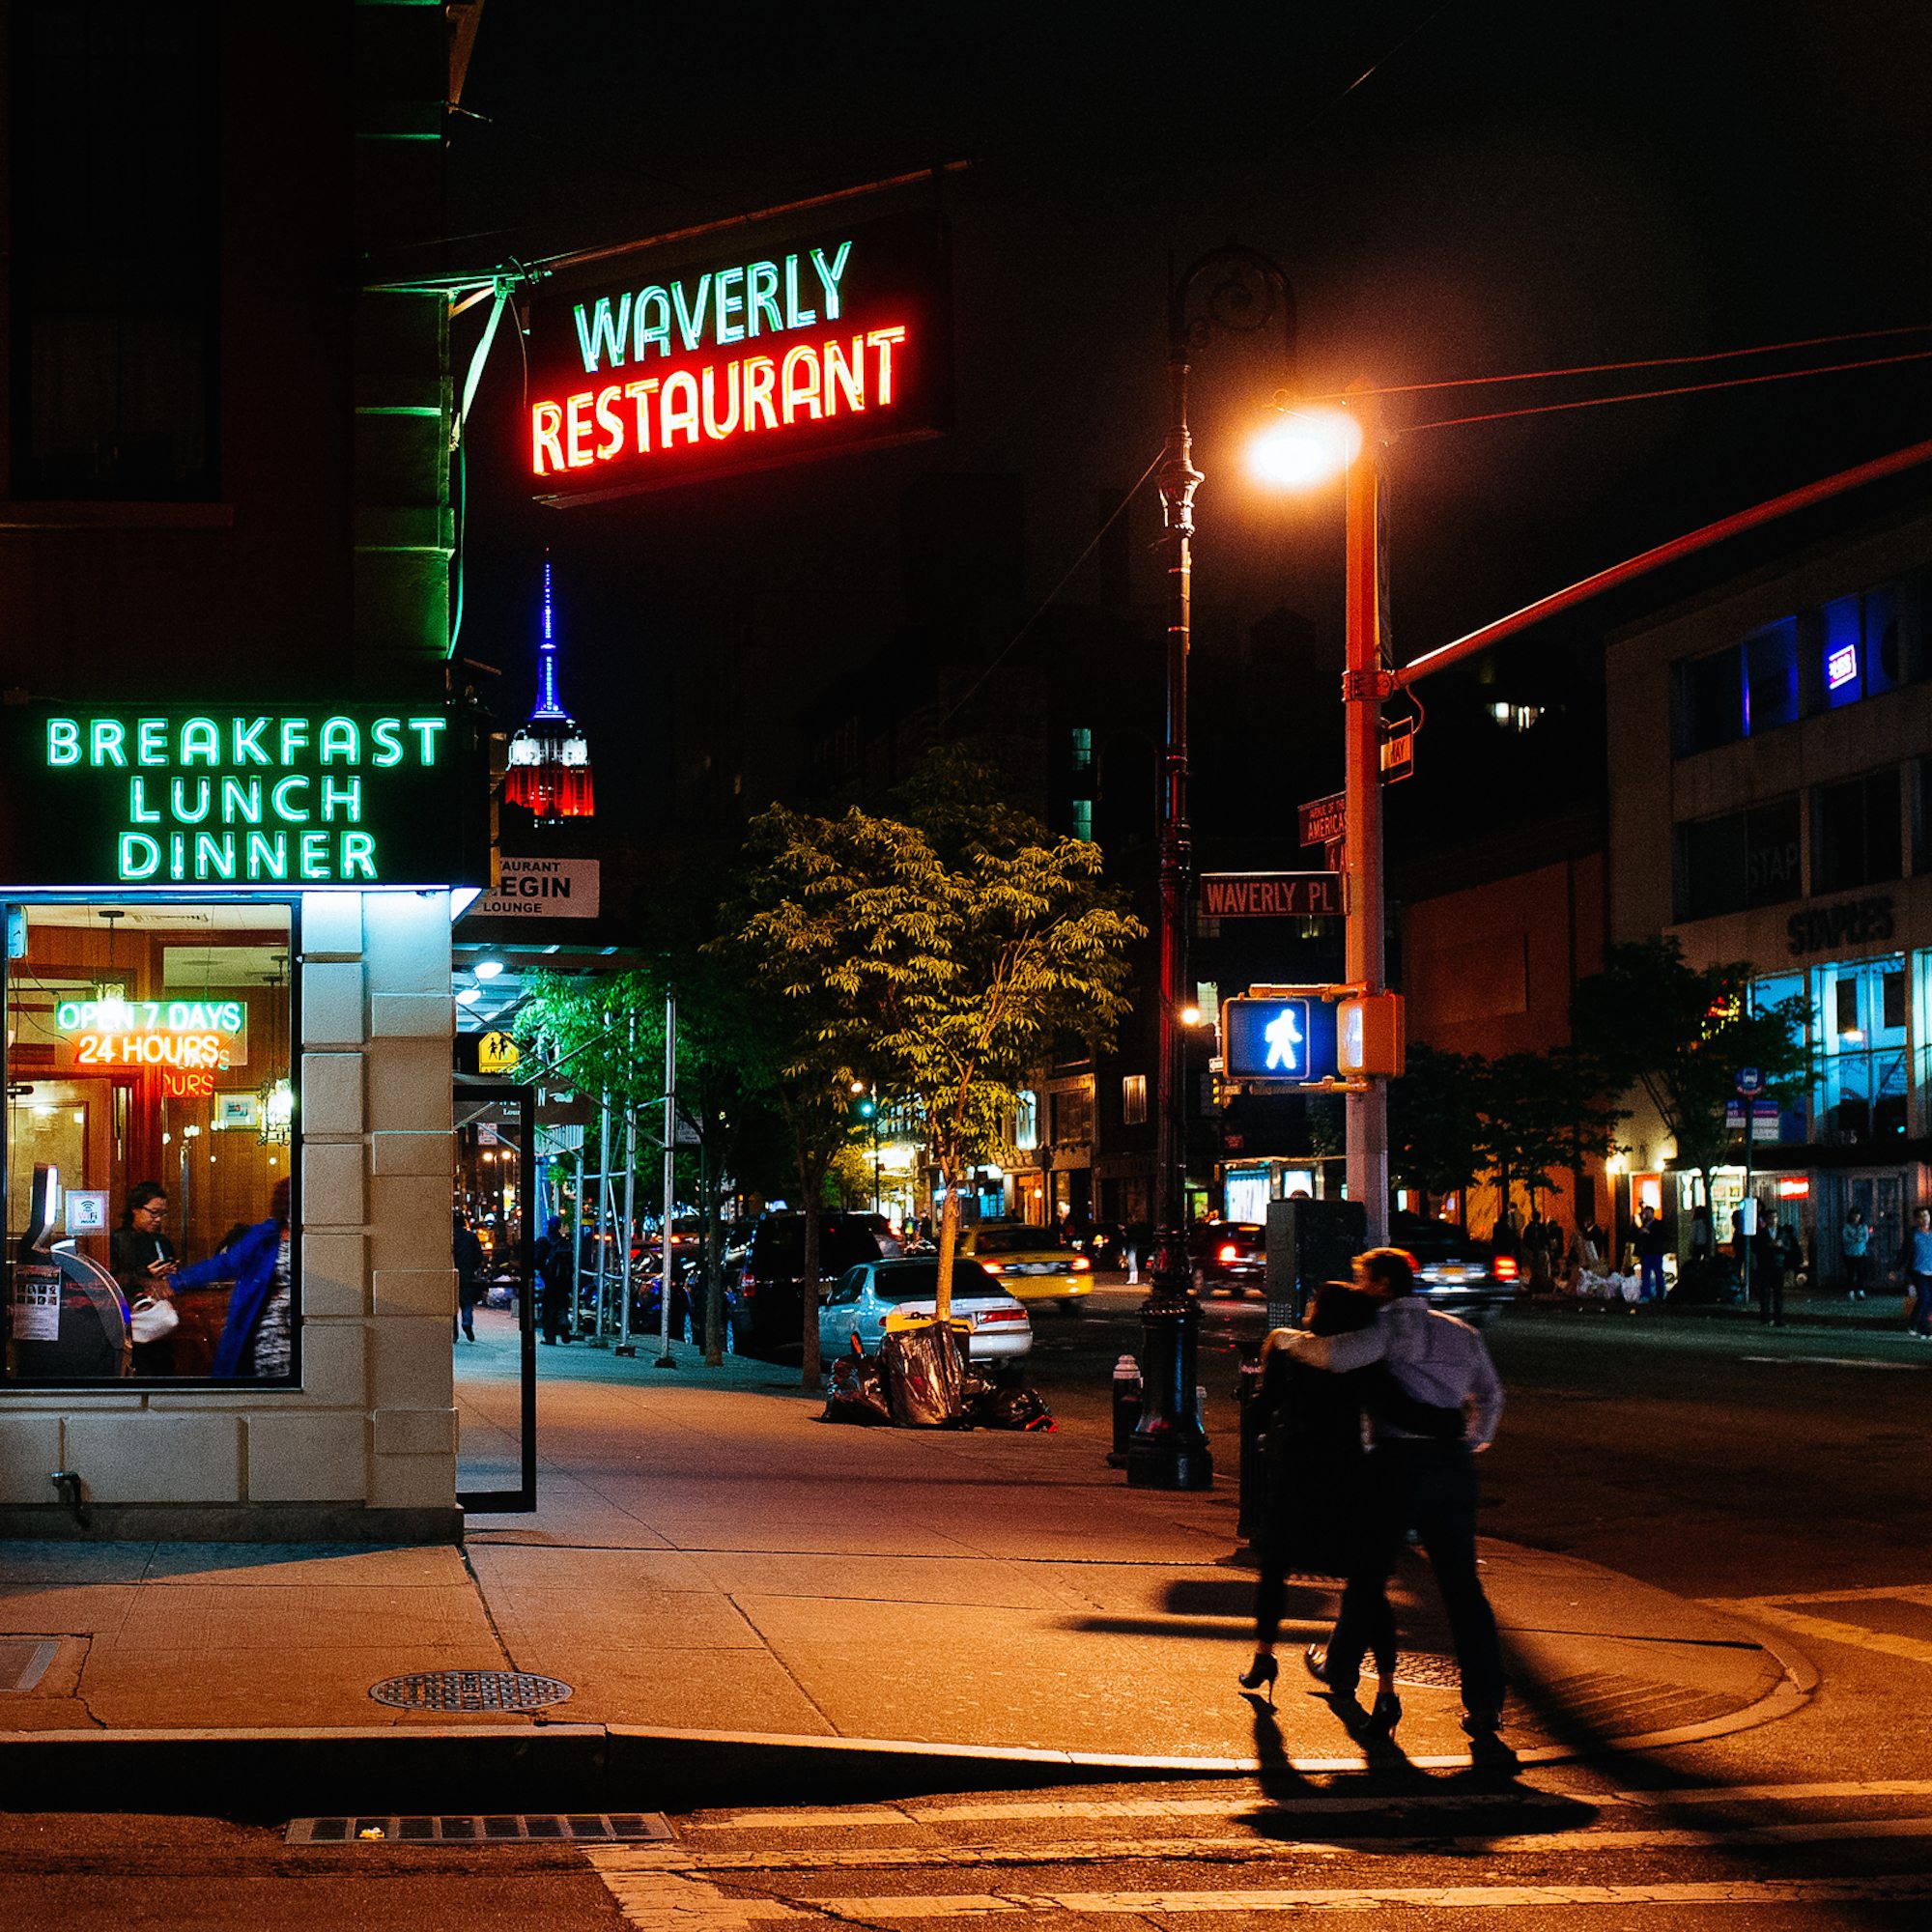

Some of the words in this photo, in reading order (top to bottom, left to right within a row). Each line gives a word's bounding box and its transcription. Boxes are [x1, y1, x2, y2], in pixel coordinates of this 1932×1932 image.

[573, 240, 853, 373] WAVERLY
[532, 326, 906, 475] RESTAURANT
[45, 717, 447, 767] BREAKFAST
[129, 775, 362, 824] LUNCH
[117, 831, 379, 880] DINNER
[500, 861, 560, 872] AURANT
[492, 876, 571, 898] EGIN
[1207, 881, 1296, 913] WAVERLY
[1308, 881, 1335, 912] PL
[484, 902, 542, 913] LOUNGE
[1788, 895, 1893, 955] STAPLES
[143, 1002, 160, 1031] 7
[168, 1003, 242, 1032] DAYS
[78, 1035, 117, 1064] 24
[123, 1035, 220, 1064] HOURS
